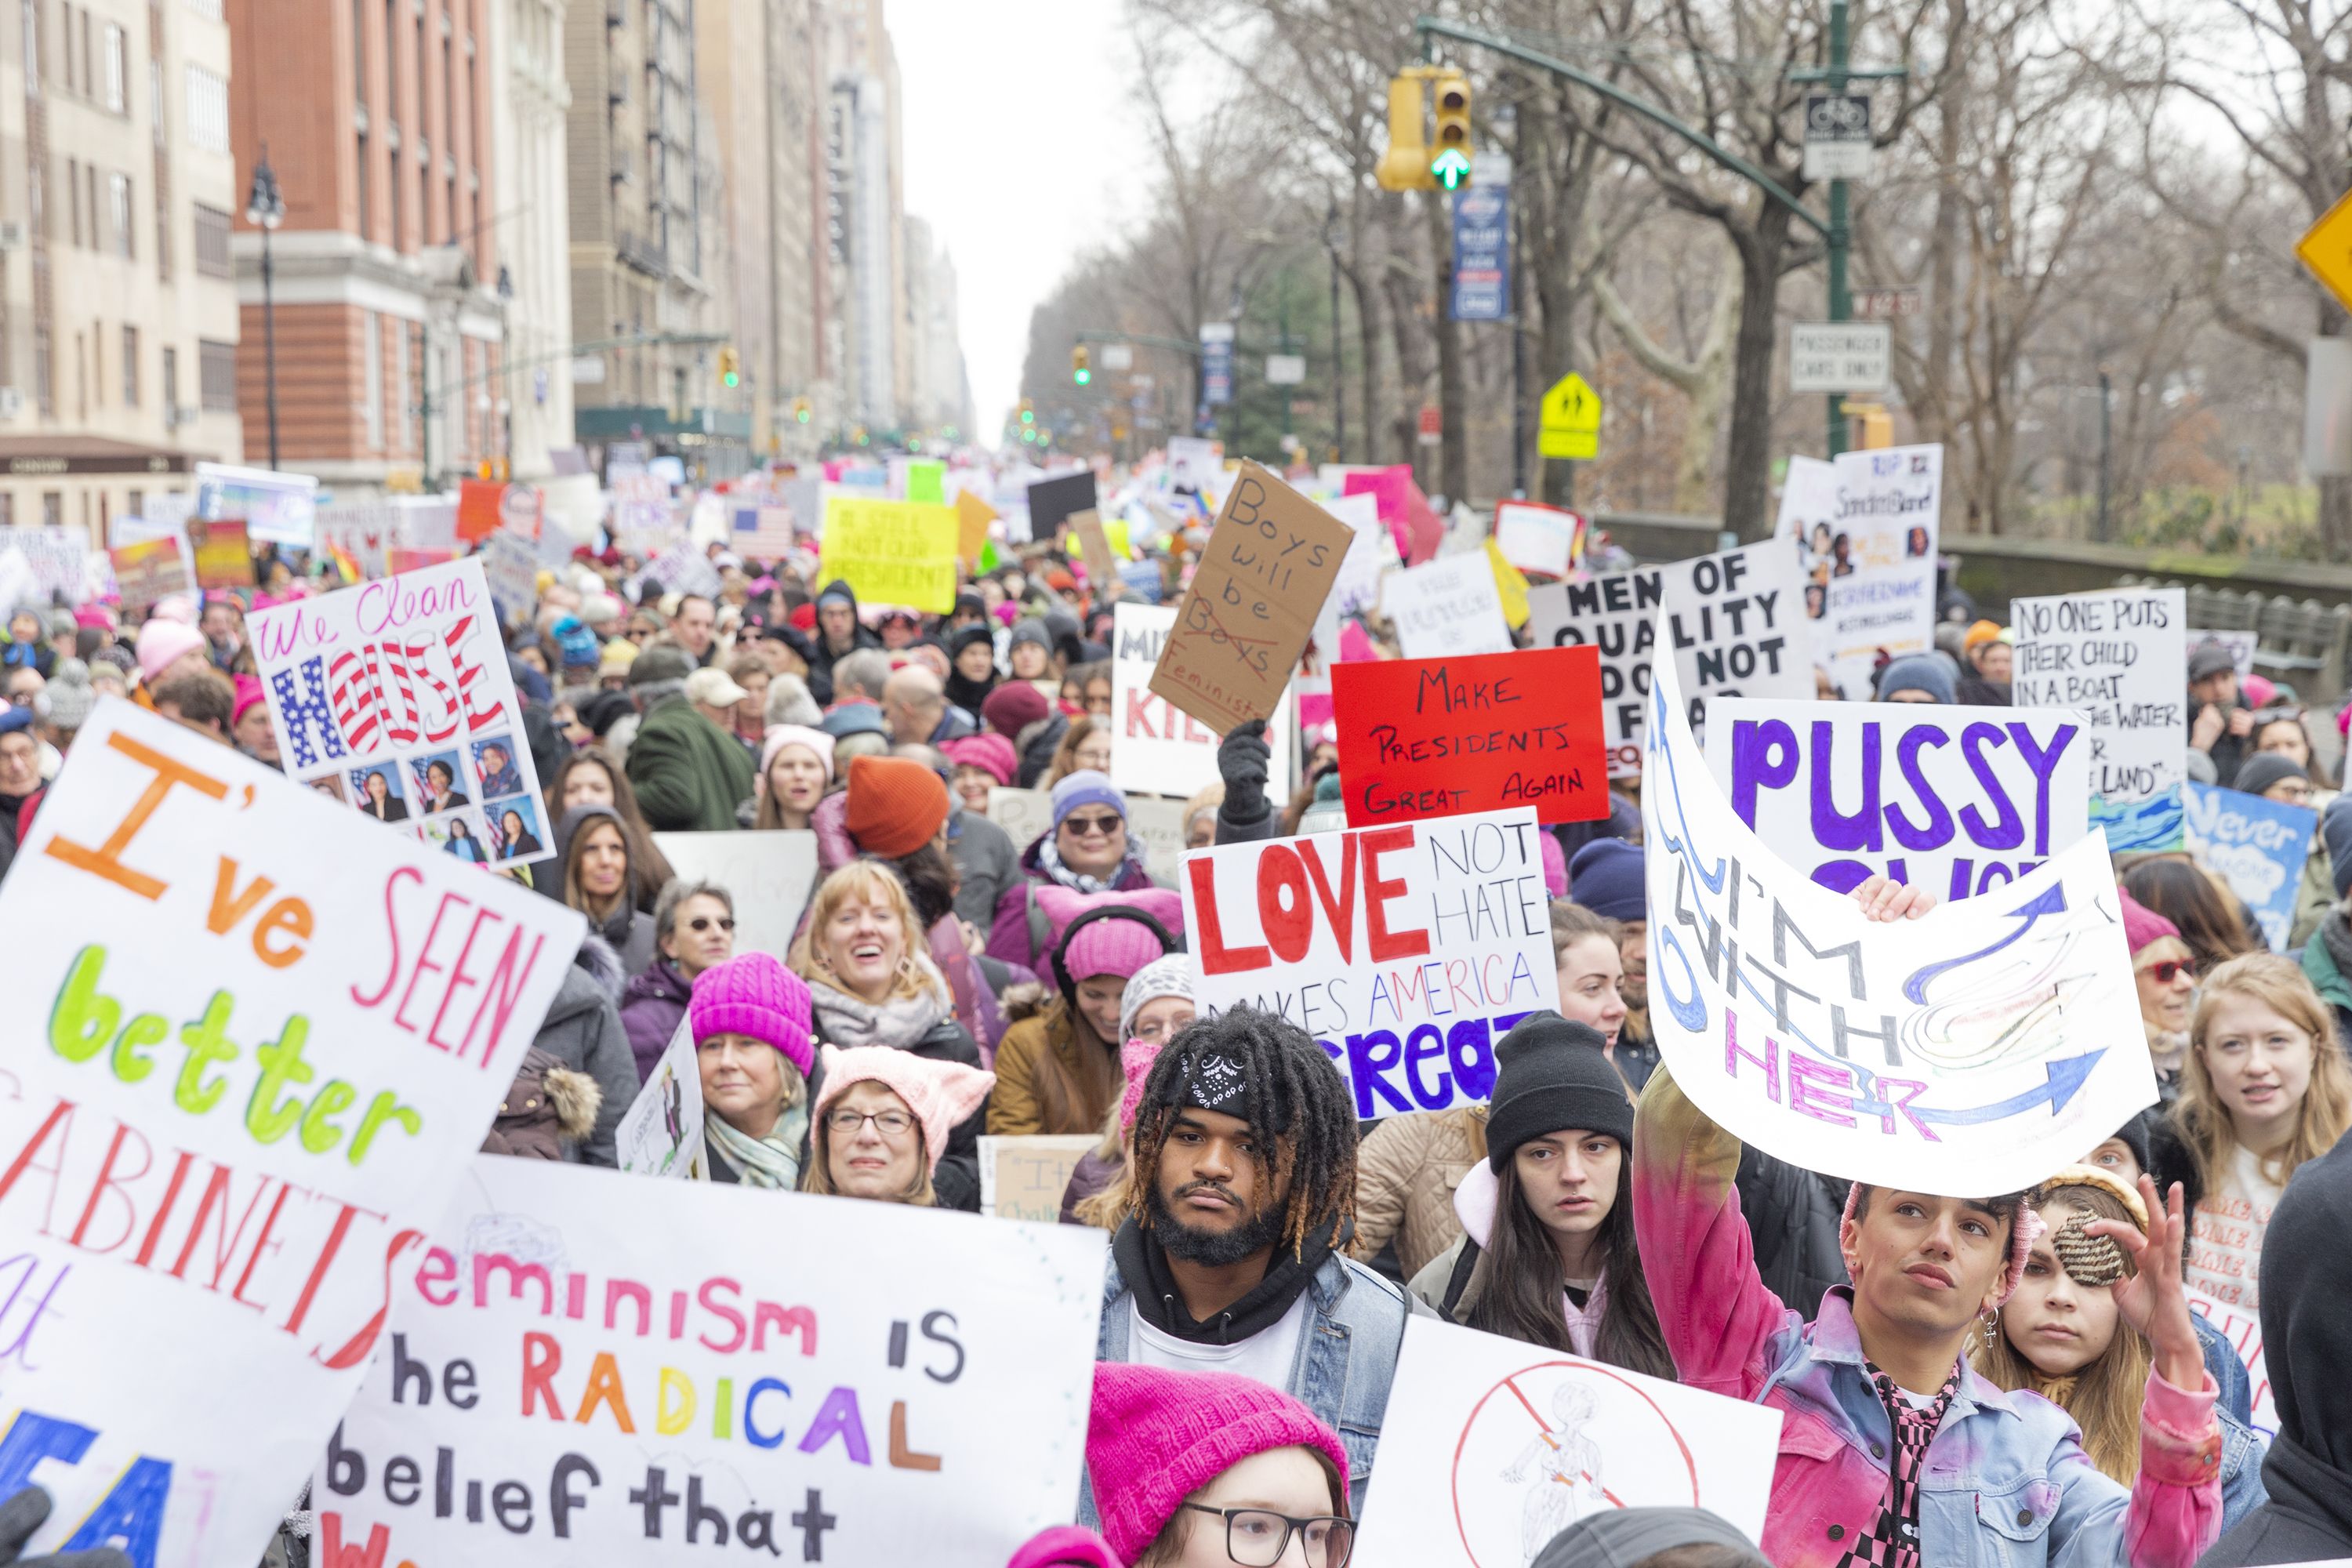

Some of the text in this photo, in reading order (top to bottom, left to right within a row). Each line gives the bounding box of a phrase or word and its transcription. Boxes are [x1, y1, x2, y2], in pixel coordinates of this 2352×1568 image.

[1228, 477, 1330, 568] Boys
[1222, 577, 1270, 619] be
[1231, 543, 1292, 590] will
[1566, 553, 1747, 617] MEN OF
[255, 608, 339, 662] We
[356, 572, 478, 636] Clean
[2016, 640, 2139, 675] THEIR CHILD
[2057, 601, 2105, 633] ONE
[2112, 598, 2169, 630] PUTS
[270, 613, 510, 769] HOUSE
[1696, 637, 1785, 687] NOT
[2017, 673, 2125, 706] IN A BOAT
[2115, 702, 2182, 728] WATER
[1730, 718, 2079, 857] PUSSY
[2180, 786, 2299, 851] Never
[43, 730, 314, 969] I've
[350, 866, 546, 1071] SEEN
[1187, 820, 1534, 977] LOVE NOT
[1434, 875, 1546, 946] HATE
[1728, 855, 1867, 1001] I'M
[1208, 951, 1540, 1036] KES AMERICA
[47, 942, 423, 1167] better
[1724, 1006, 1944, 1143] HER
[391, 1330, 944, 1473] he RADICAL
[325, 1417, 602, 1538] belief
[629, 1465, 837, 1563] that
